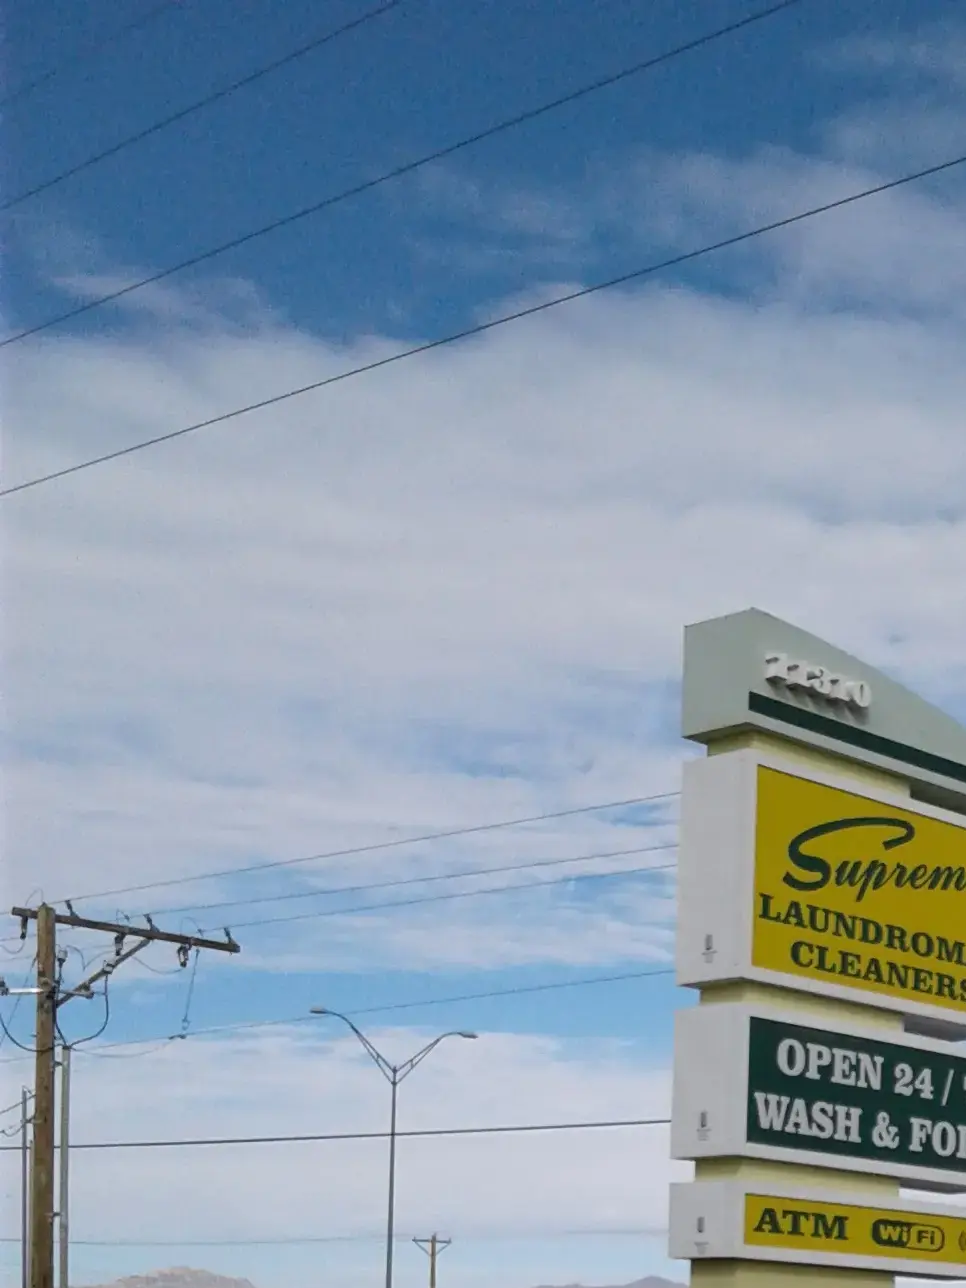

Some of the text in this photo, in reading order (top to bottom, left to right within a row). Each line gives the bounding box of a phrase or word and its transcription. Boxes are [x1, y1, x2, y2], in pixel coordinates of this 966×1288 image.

[777, 1038, 884, 1090] OPEN
[754, 1091, 862, 1143] WASH
[871, 1111, 900, 1149] &
[753, 1207, 849, 1241] ATM
